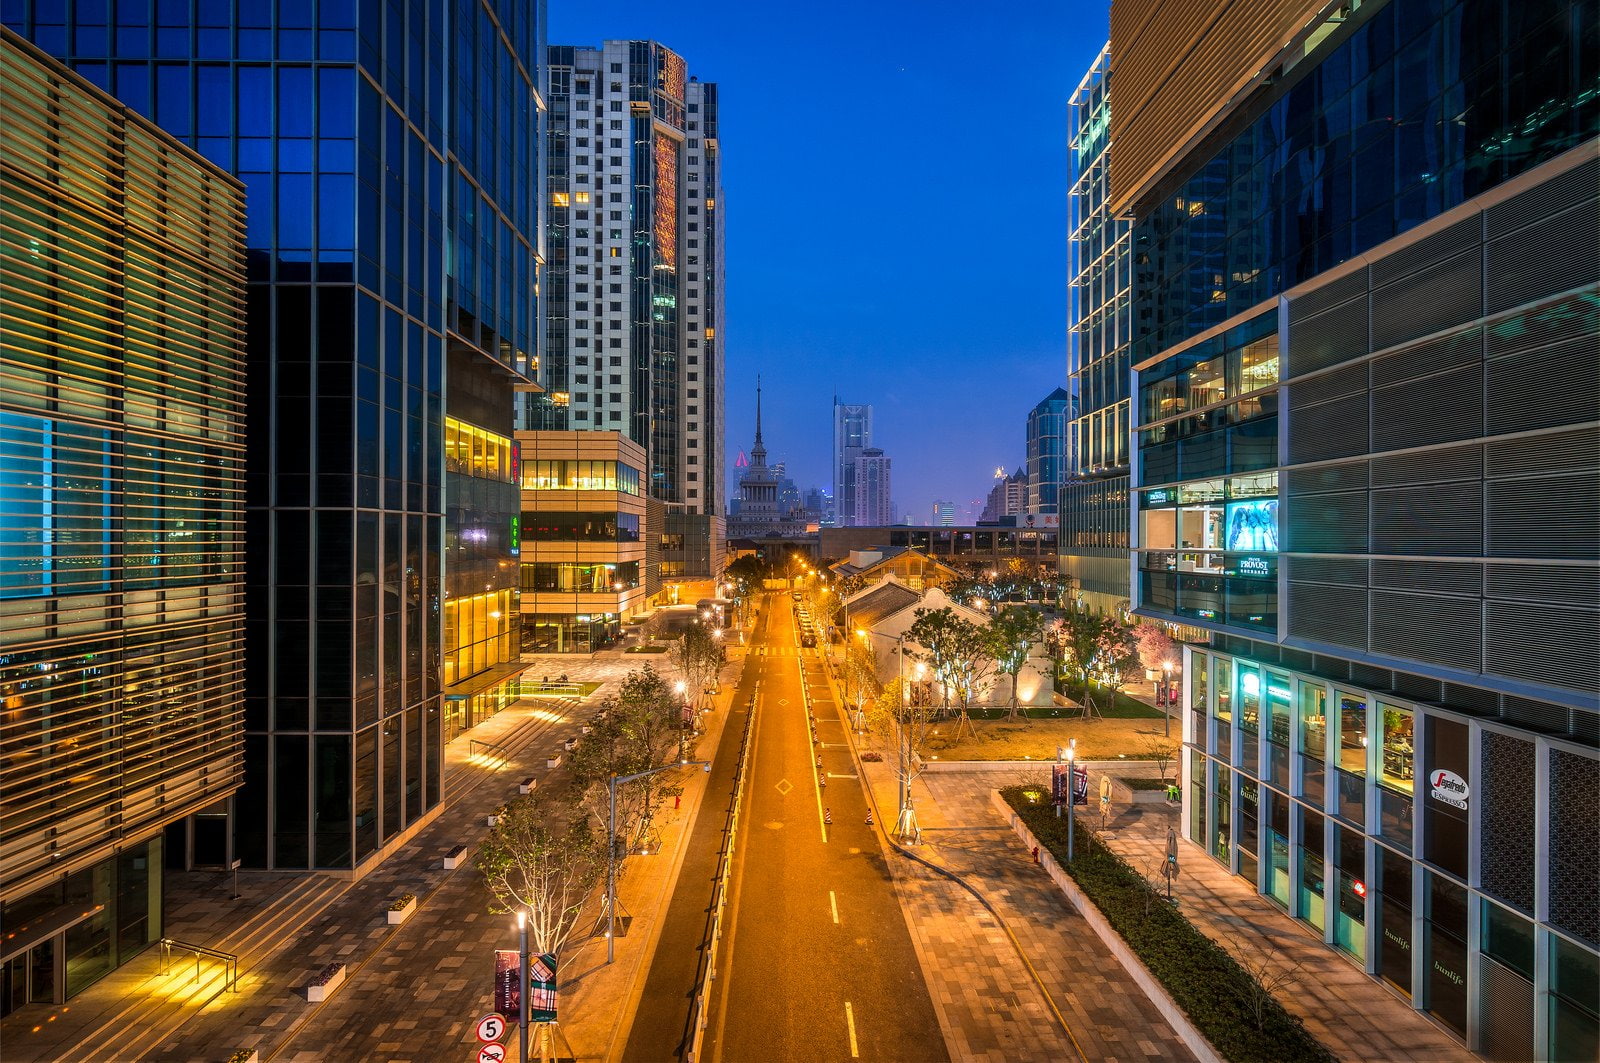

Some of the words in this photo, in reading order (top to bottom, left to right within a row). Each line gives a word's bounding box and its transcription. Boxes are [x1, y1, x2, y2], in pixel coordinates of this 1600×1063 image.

[1240, 560, 1269, 570] PROVOST
[1433, 772, 1466, 794] Segafredo
[1434, 791, 1466, 809] ESPRESSO
[1384, 928, 1410, 951] bunlife
[1434, 960, 1464, 986] bunlife
[485, 1020, 496, 1038] 5
